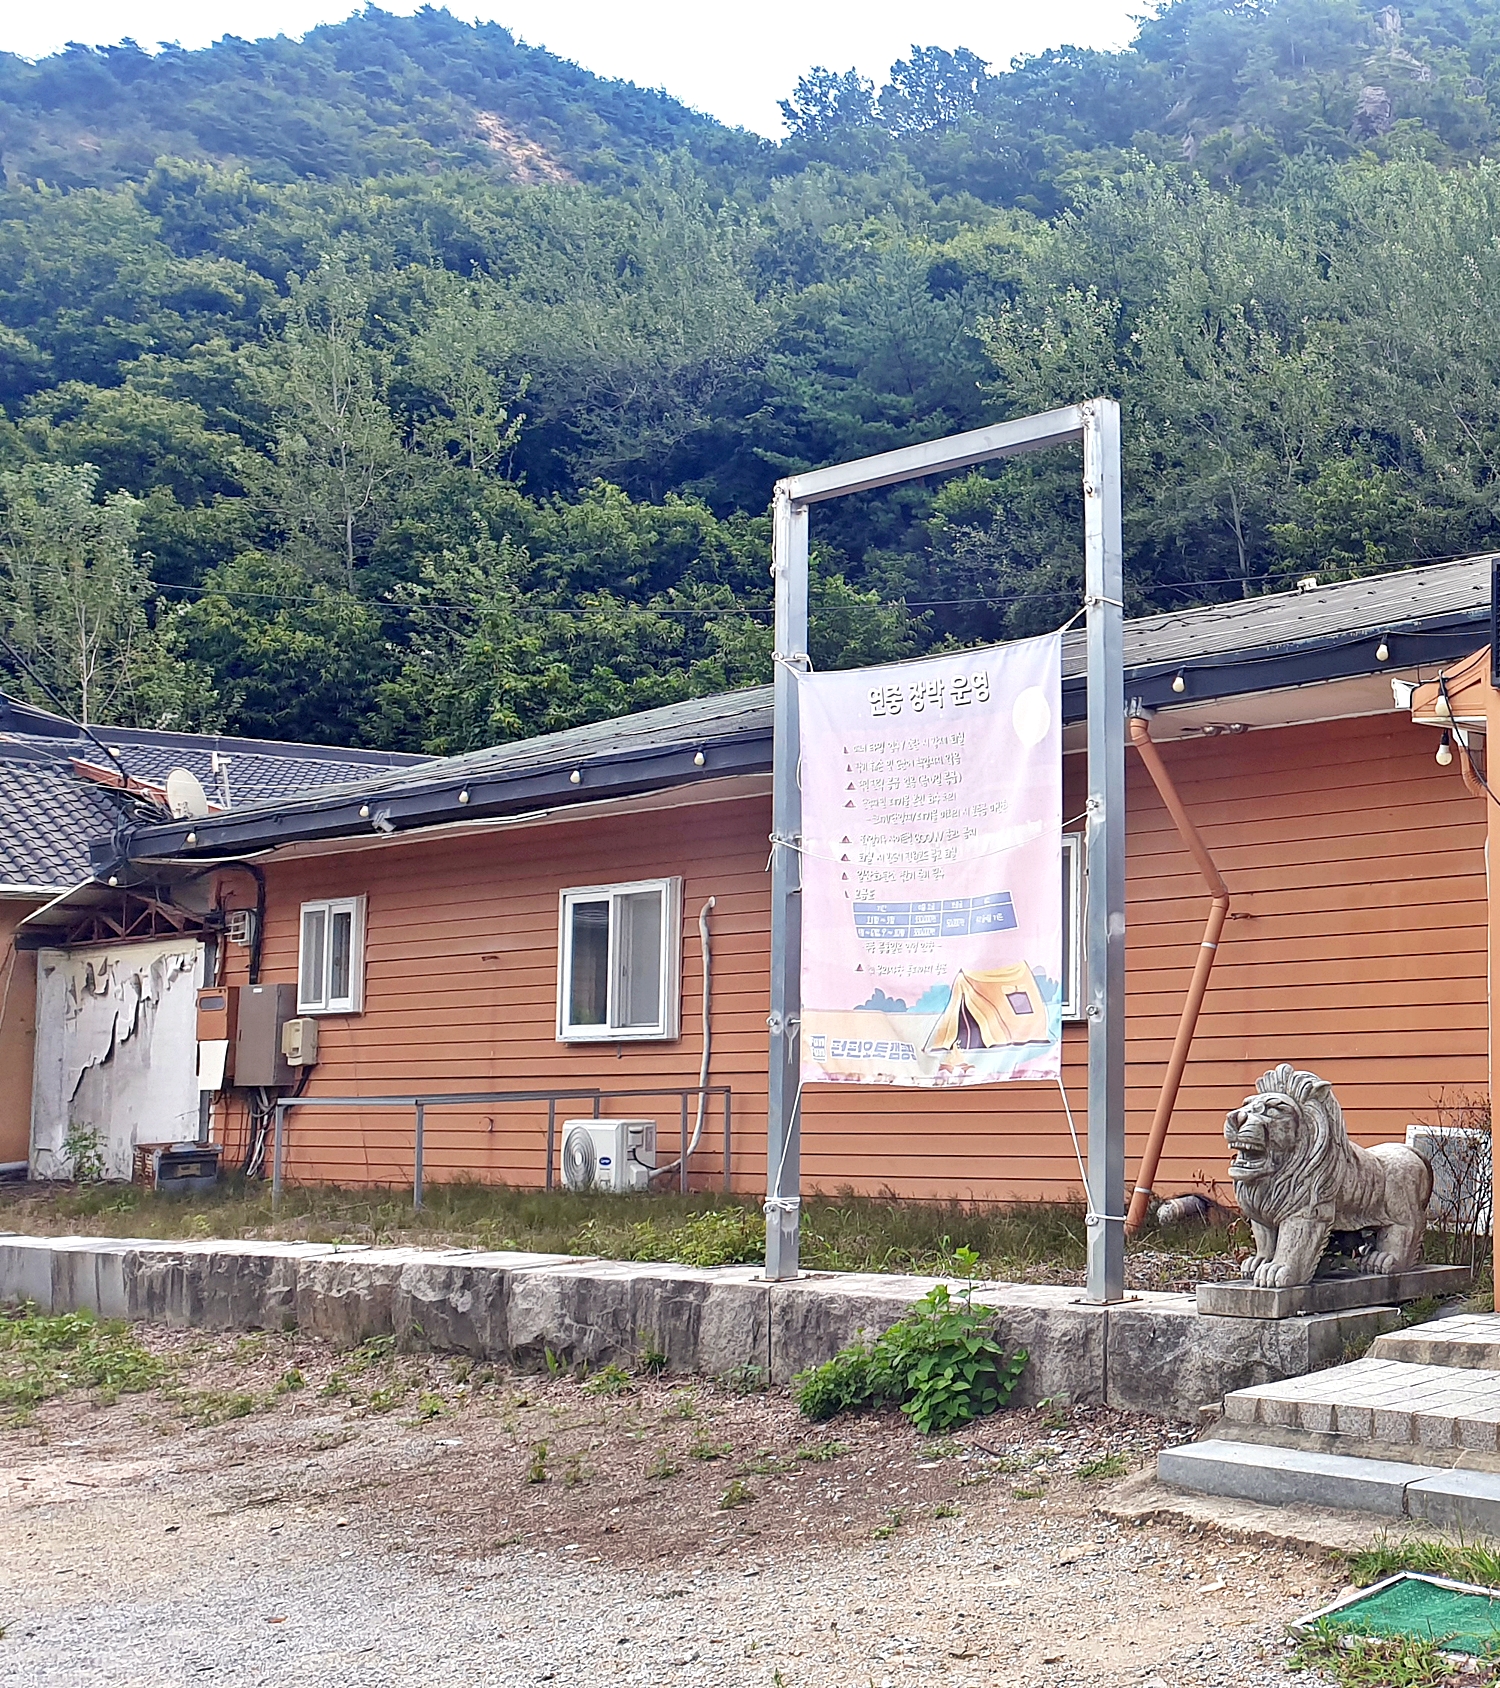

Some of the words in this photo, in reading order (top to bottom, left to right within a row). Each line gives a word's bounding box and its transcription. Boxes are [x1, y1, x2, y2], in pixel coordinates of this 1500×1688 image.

[868, 684, 904, 717] 연중
[908, 680, 945, 713] 장박
[950, 671, 990, 707] 운영
